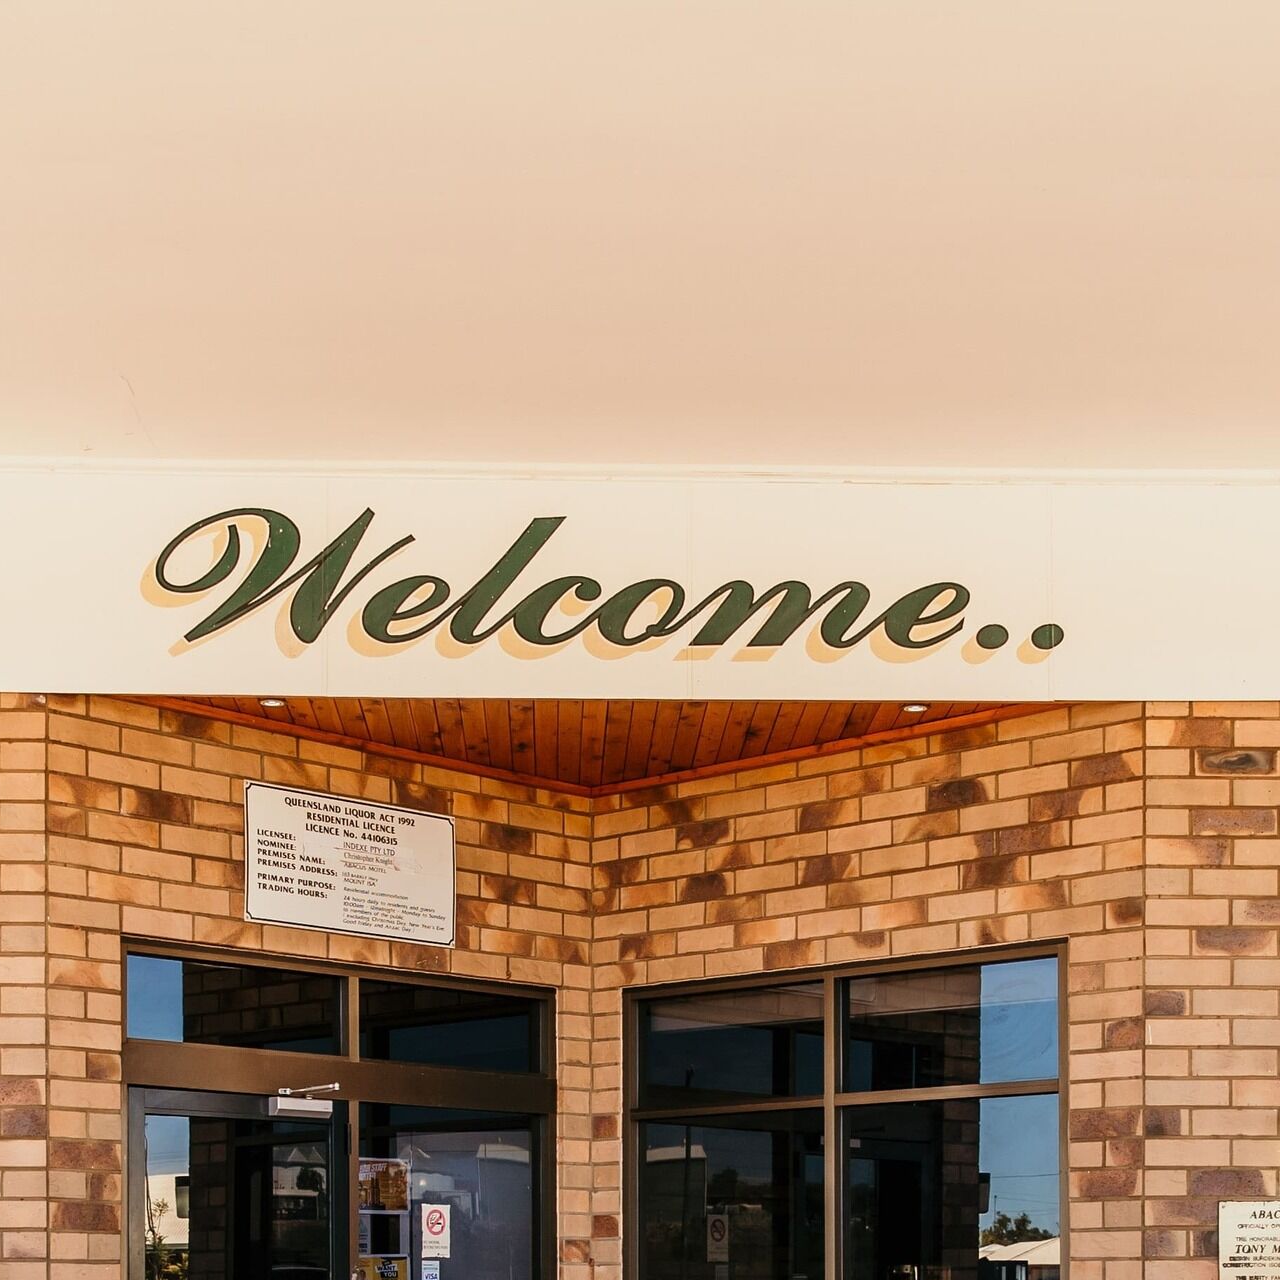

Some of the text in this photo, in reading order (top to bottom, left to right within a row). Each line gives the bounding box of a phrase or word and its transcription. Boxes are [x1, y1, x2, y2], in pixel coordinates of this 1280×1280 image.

[284, 796, 416, 826] QUEENSLAND LIQUOR ACT 1992
[306, 812, 396, 834] RESIDENTIAL LICENCE
[257, 828, 296, 840] LICENSEE:
[306, 822, 398, 846] LICENCE No. 44106315
[257, 839, 296, 850] NOMINEE:
[370, 846, 382, 854] PTY
[258, 848, 326, 865] PREMISES NAME:
[258, 858, 338, 876] PREMISES ADDRESS:
[344, 862, 386, 874] ABACUS MOTEL
[258, 873, 336, 890] PRIMARY PURPOSE:
[344, 878, 365, 886] MOUNT
[258, 882, 328, 898] TRADING HOURS:
[1236, 1244, 1266, 1254] TONY
